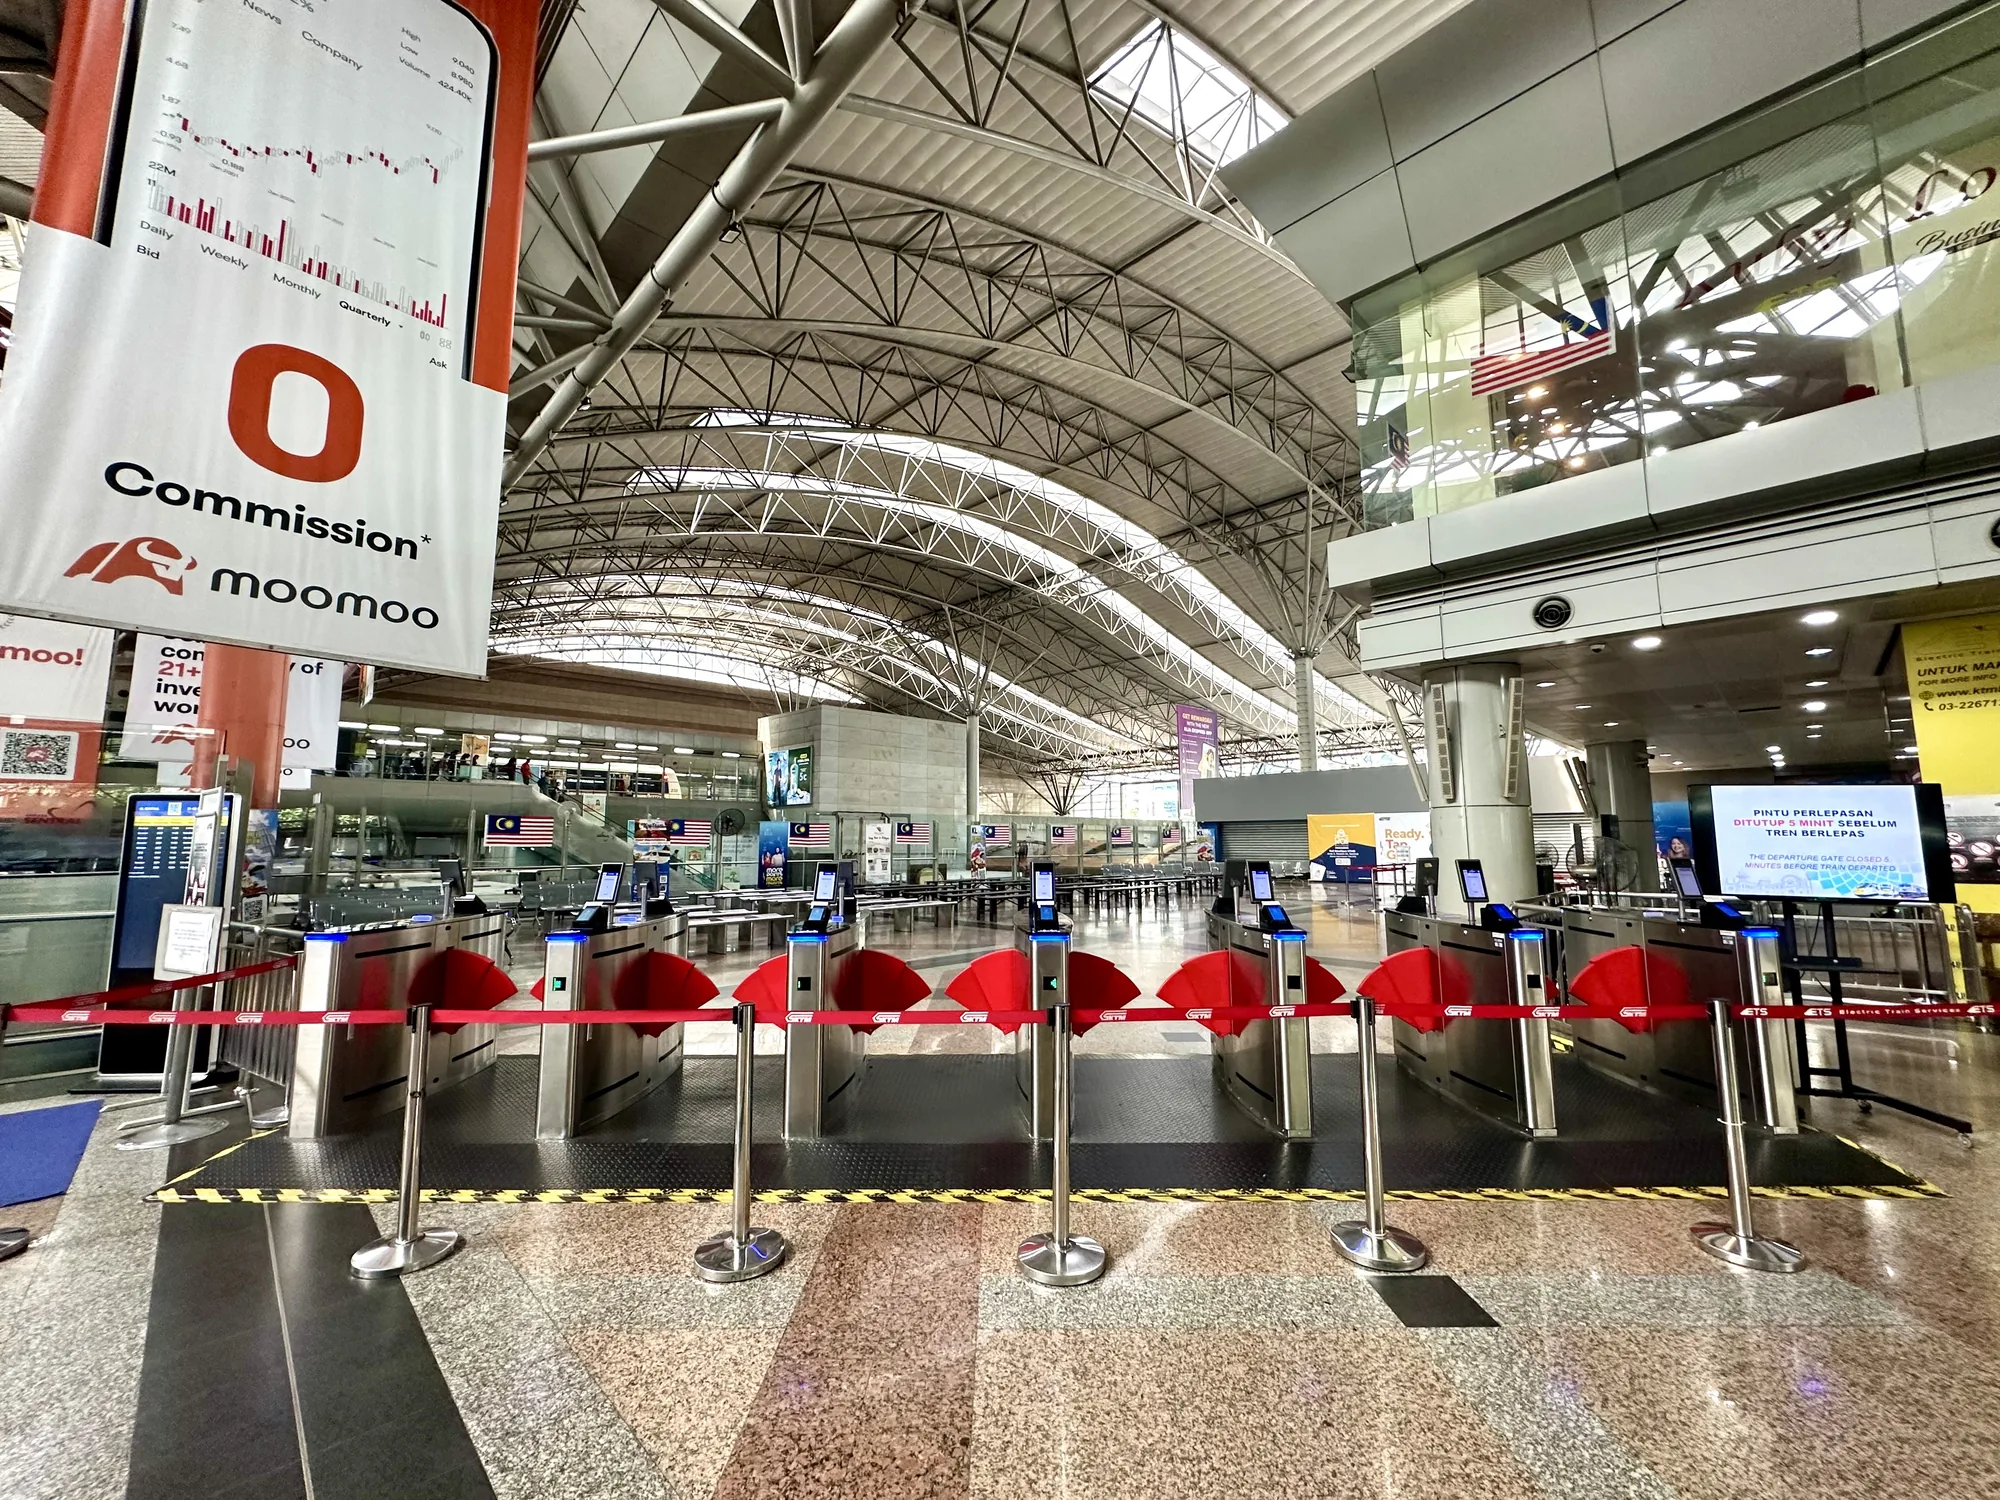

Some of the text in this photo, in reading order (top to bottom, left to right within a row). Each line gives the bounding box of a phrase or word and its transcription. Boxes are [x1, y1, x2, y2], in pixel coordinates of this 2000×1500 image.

[243, 0, 282, 25] News
[401, 27, 421, 43] High
[301, 30, 363, 71] Company
[400, 41, 418, 56] Low
[399, 56, 431, 79] Volume
[452, 57, 475, 75] 9.040
[148, 161, 177, 177] 22M
[1915, 219, 2000, 256] Busin
[140, 220, 391, 327] Daily Weekly Monthly Quarterly
[136, 244, 448, 370] Bid Ask
[210, 567, 439, 629] moomoo
[158, 660, 201, 677] 21+
[300, 662, 324, 675] of
[1917, 664, 1968, 677] UNTUK
[1918, 673, 1998, 687] FOR MORE INFO
[1939, 699, 2000, 711] 03-22671
[1753, 809, 1874, 818] PINTU PERLEPASAN
[1734, 819, 1897, 828] DITUTUP 5 MINIT SEBELUM
[1384, 828, 1425, 842] Ready.
[1765, 829, 1865, 838] TREN BERLEPAS
[1767, 853, 1819, 861] DEPARTURE
[1846, 855, 1882, 863] CLOSED
[1820, 863, 1847, 871] TRAIN
[1848, 864, 1896, 872] DEPARTED
[1740, 1007, 1769, 1016] ETS
[1803, 1007, 1832, 1016] ETS
[1966, 1004, 1995, 1013] ETS
